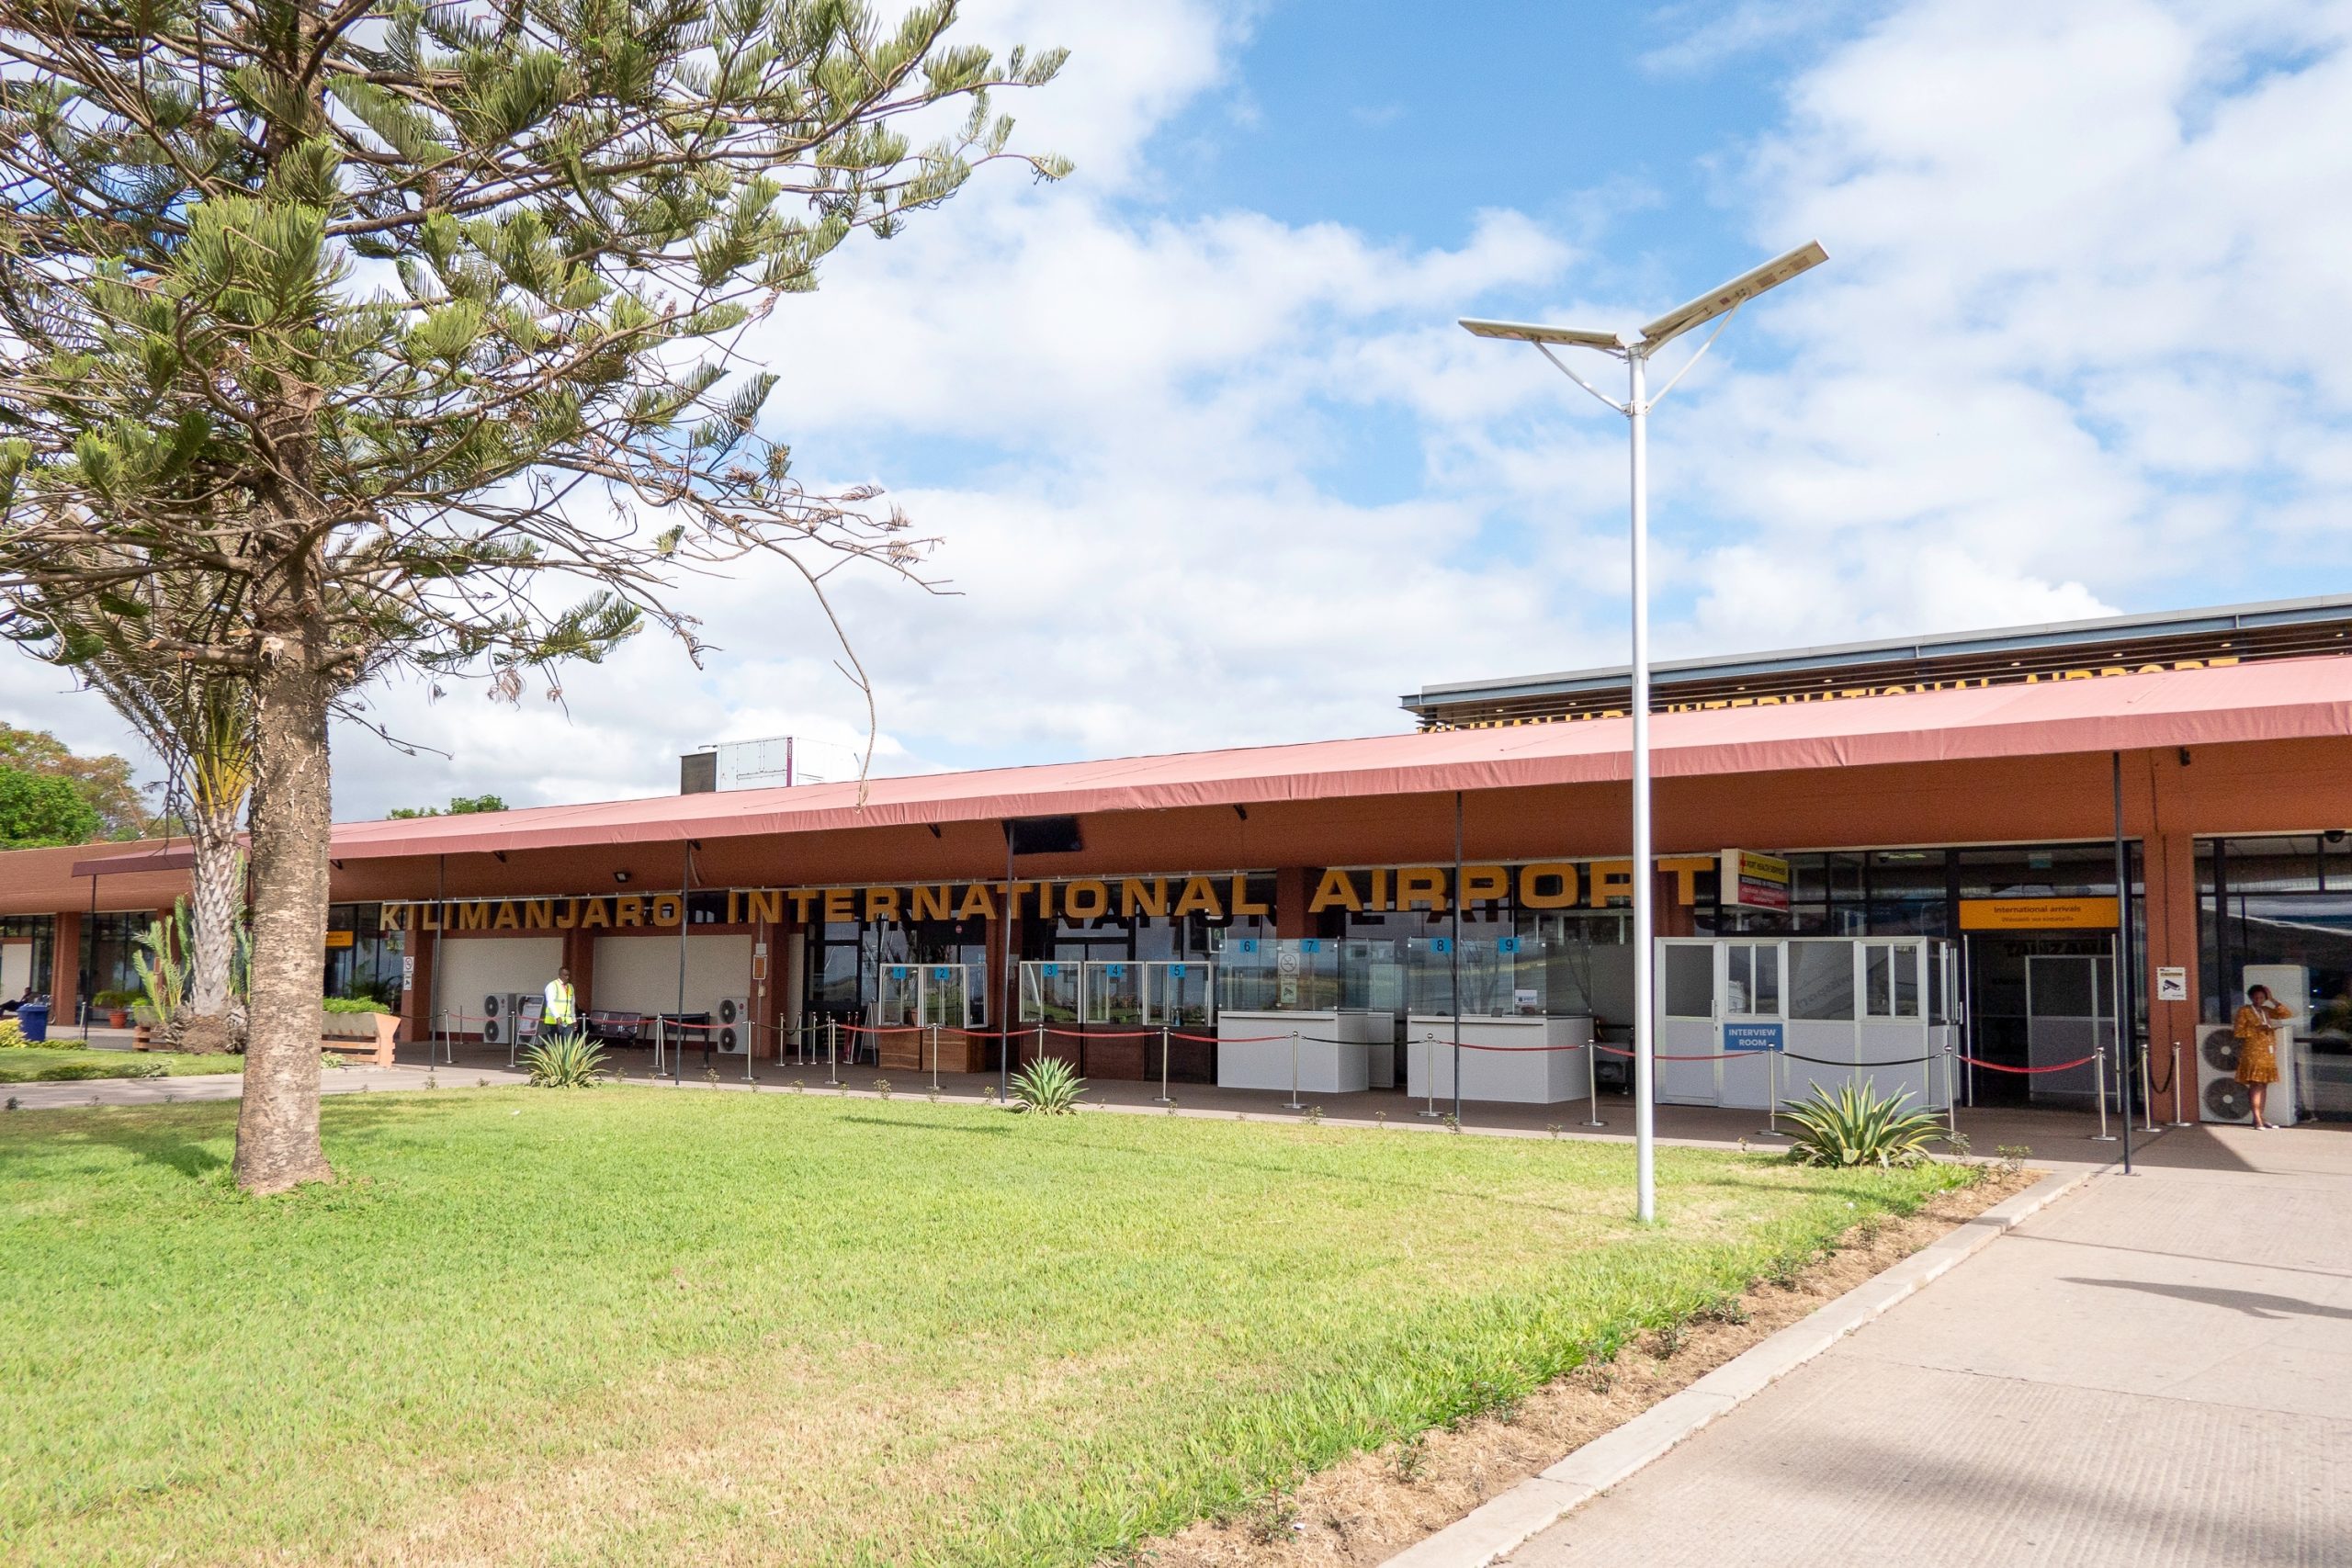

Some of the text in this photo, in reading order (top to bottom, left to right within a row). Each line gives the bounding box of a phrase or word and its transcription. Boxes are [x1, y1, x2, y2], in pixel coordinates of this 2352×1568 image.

[379, 858, 1715, 931] KILIMANJARO INTERNATIONAL AIRPORT
[1994, 905, 2081, 913] International arrivals
[1243, 941, 1250, 952] 6
[1307, 941, 1314, 952] 7
[1436, 939, 1444, 952] 8
[1505, 939, 1513, 952] 9
[939, 968, 945, 978] 2
[1047, 964, 1053, 976] 3
[1112, 964, 1118, 976] 4
[1174, 965, 1181, 976] 5
